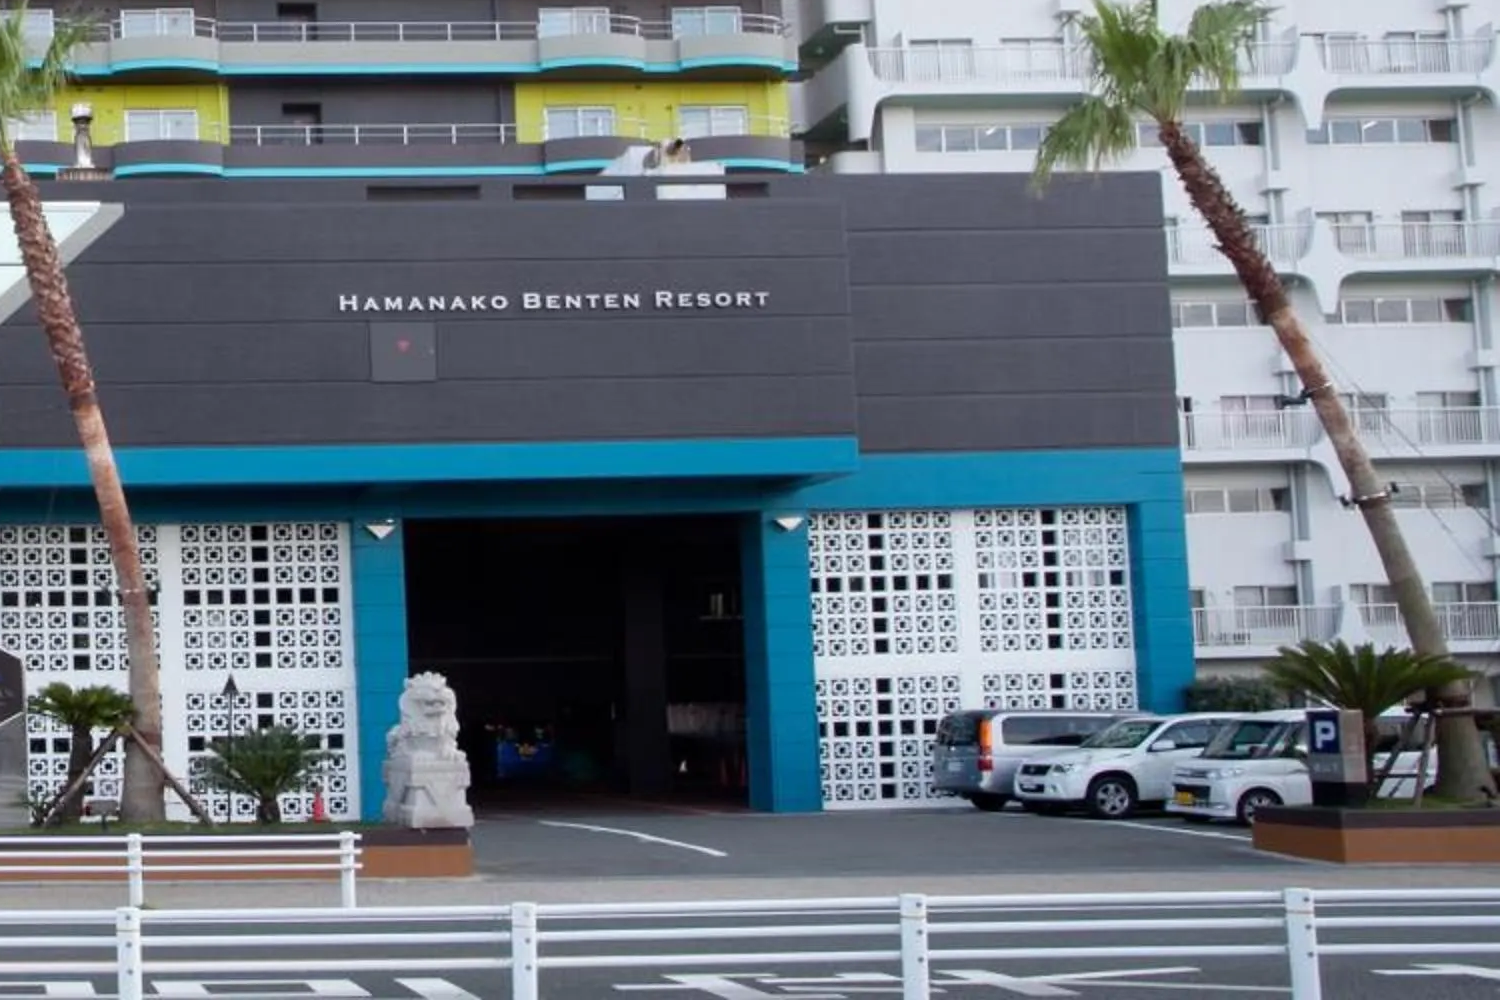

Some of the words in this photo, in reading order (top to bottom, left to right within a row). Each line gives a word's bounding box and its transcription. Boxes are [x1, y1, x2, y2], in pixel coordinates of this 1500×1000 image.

[339, 291, 509, 313] HAMANAKO
[522, 290, 640, 311] BENTEN
[655, 288, 770, 309] RESORT
[1314, 720, 1336, 750] P
